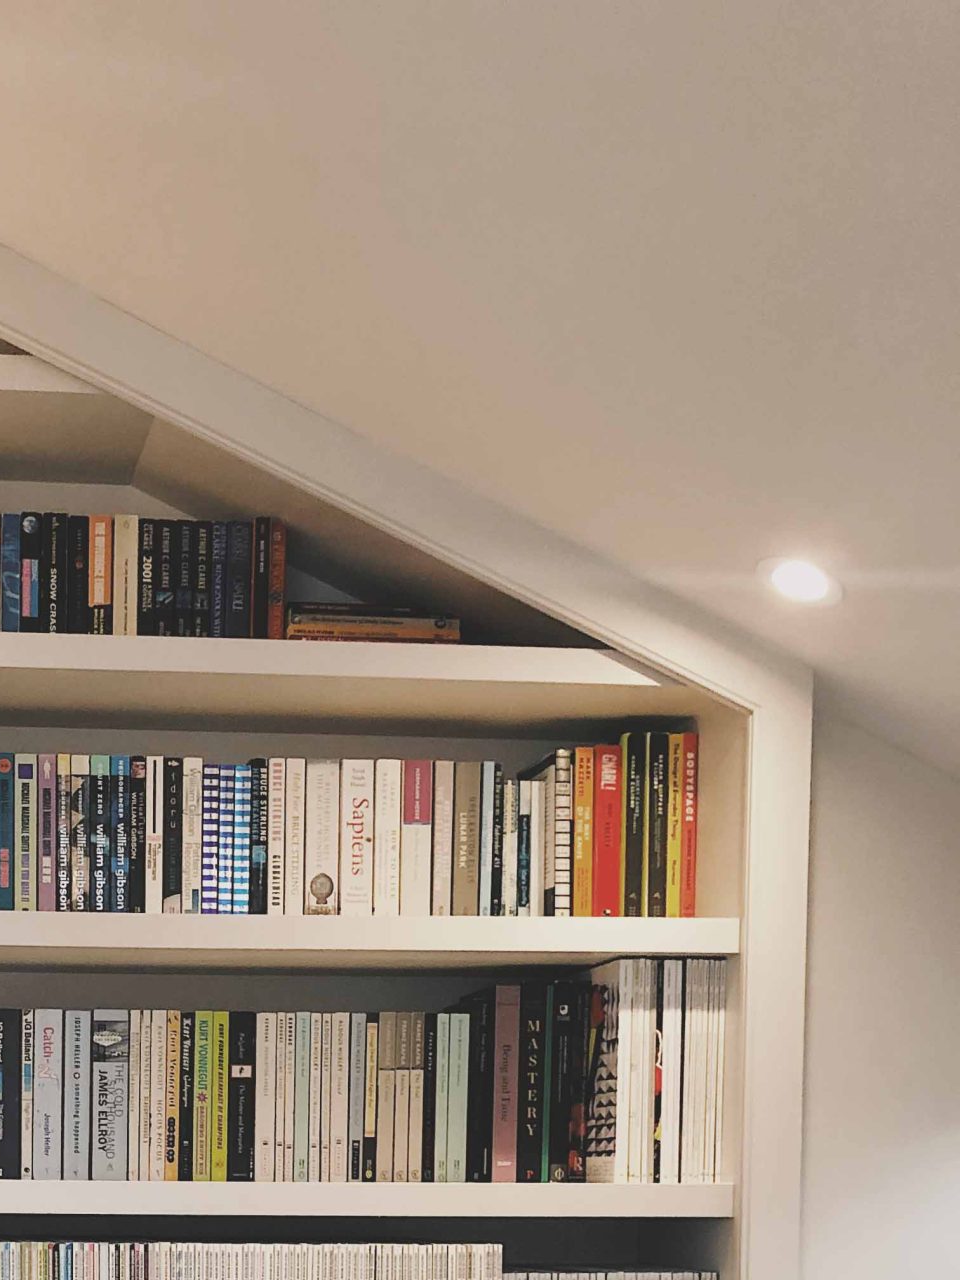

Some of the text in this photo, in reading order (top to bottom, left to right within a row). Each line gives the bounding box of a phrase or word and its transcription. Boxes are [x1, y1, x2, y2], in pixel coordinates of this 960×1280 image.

[197, 528, 206, 554] ARTHUR
[142, 555, 152, 583] 2001
[197, 565, 206, 589] CLARKE
[49, 568, 57, 633] SNOW CRAS
[601, 754, 617, 791] GNARL!
[685, 752, 693, 822] BODYSPACE
[259, 768, 267, 842] BRUCE STERLING
[96, 824, 104, 866] william
[117, 823, 126, 865] william
[347, 797, 371, 876] Sapiens
[459, 812, 467, 868] LUNAR PARK
[58, 824, 69, 911] william gibson
[114, 869, 126, 910] gibson
[94, 870, 104, 911] gibson
[24, 1018, 32, 1062] JG Ballard
[198, 1020, 208, 1091] KURT VONNEGUT
[114, 1064, 124, 1084] THE
[526, 1019, 540, 1137] MASTERY
[98, 1069, 108, 1152] JAMES ELLROY
